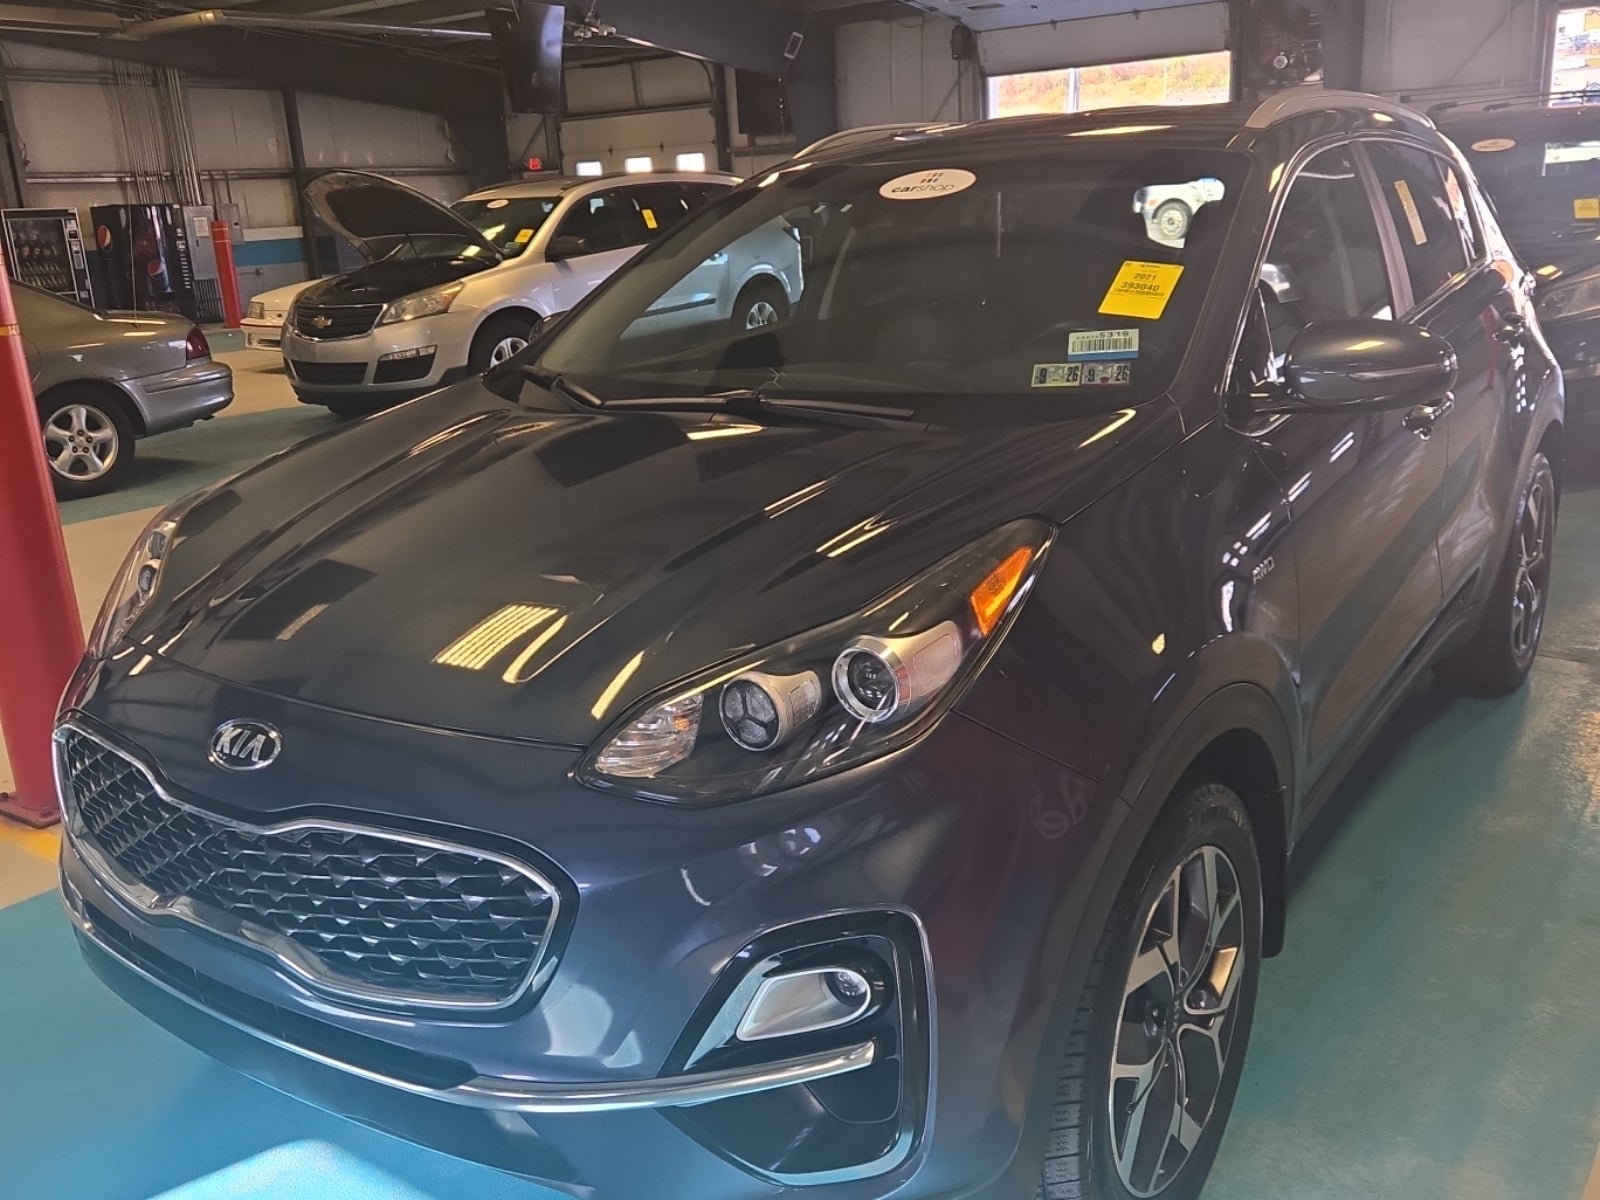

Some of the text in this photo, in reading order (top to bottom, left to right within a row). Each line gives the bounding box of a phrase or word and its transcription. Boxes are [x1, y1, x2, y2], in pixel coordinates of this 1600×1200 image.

[891, 184, 955, 193] carshop
[1133, 273, 1157, 281] 2021
[1121, 281, 1160, 292] 393040
[1038, 366, 1079, 384] 9 26
[1087, 365, 1129, 383] 9 26
[215, 726, 266, 762] KIA
